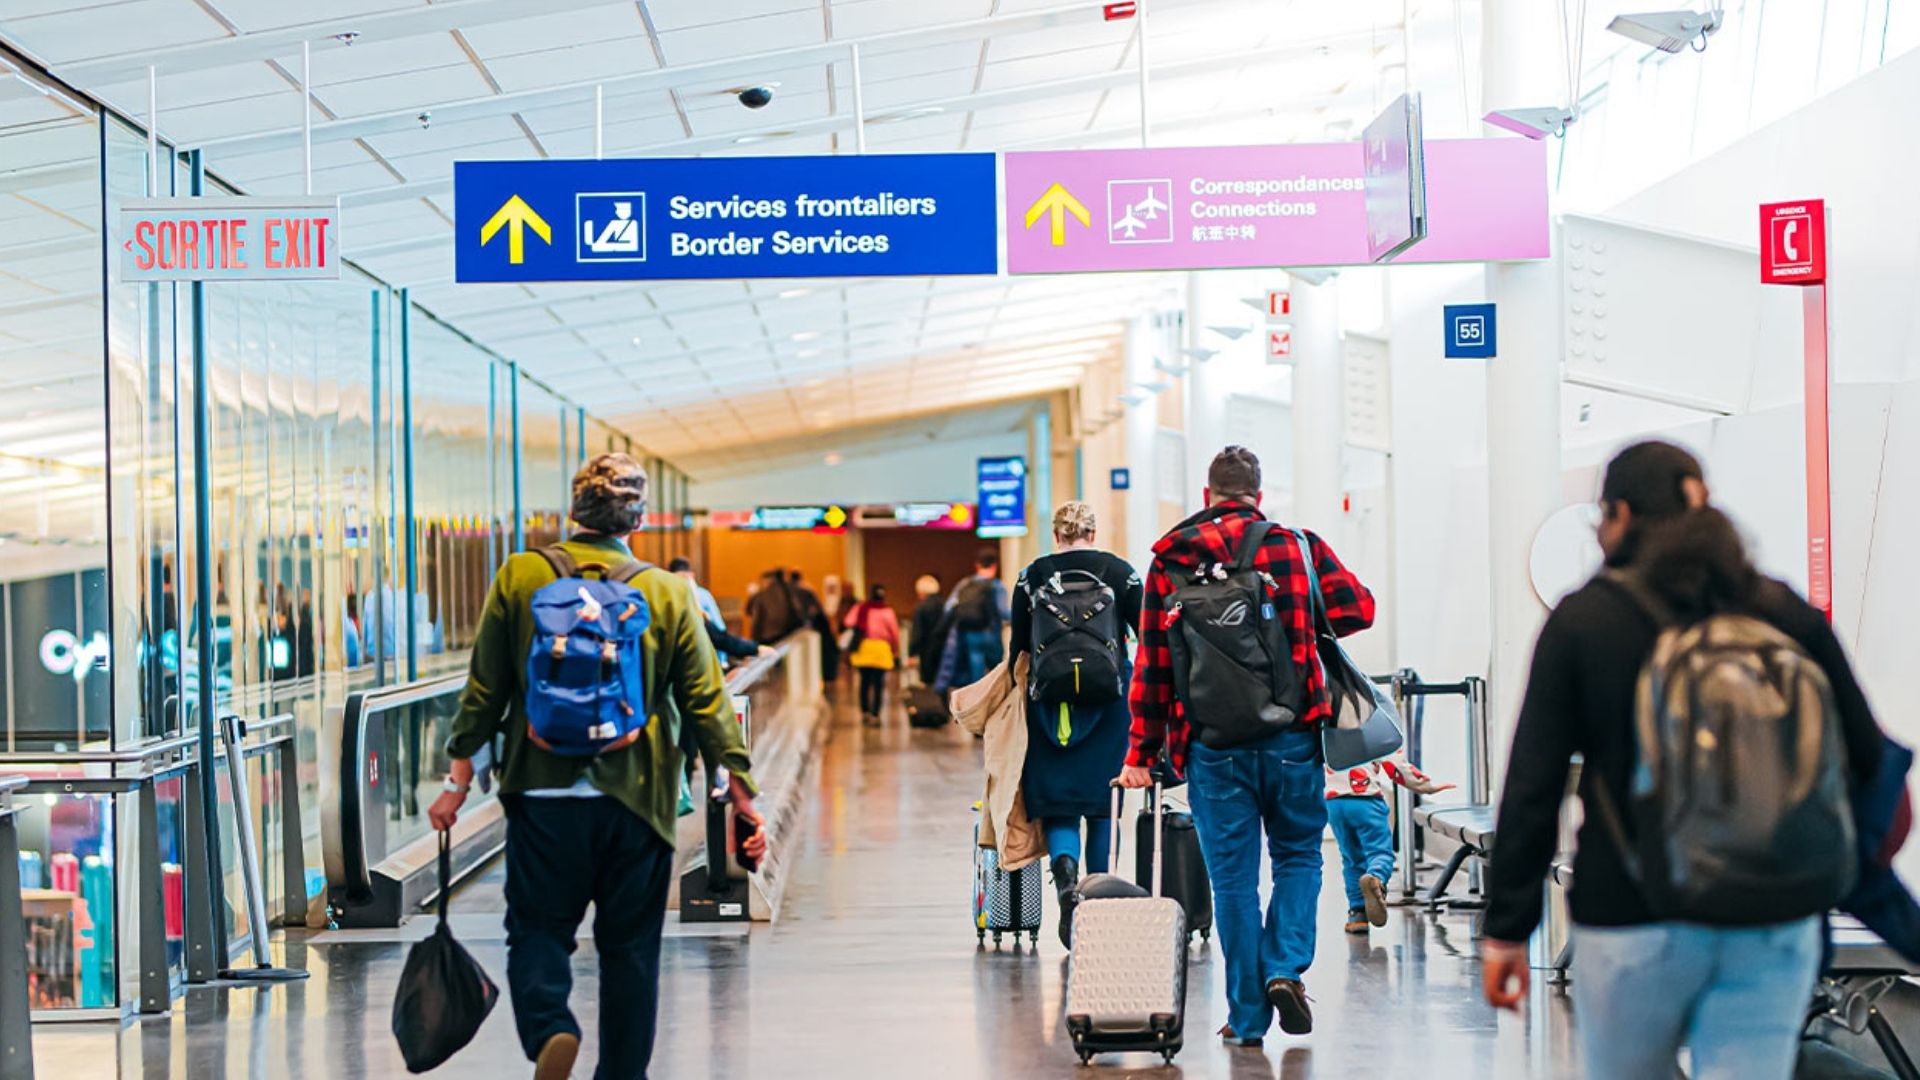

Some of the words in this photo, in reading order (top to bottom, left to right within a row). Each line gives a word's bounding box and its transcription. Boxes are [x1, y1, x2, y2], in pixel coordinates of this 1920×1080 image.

[1190, 175, 1364, 197] Correspondances
[670, 194, 787, 219] Services
[795, 192, 937, 217] frontaliers
[1190, 199, 1317, 219] Connections
[135, 219, 248, 270] SORTIE
[264, 217, 330, 268] EXIT
[671, 231, 764, 257] Border
[772, 229, 889, 255] Services
[1459, 322, 1481, 339] 55
